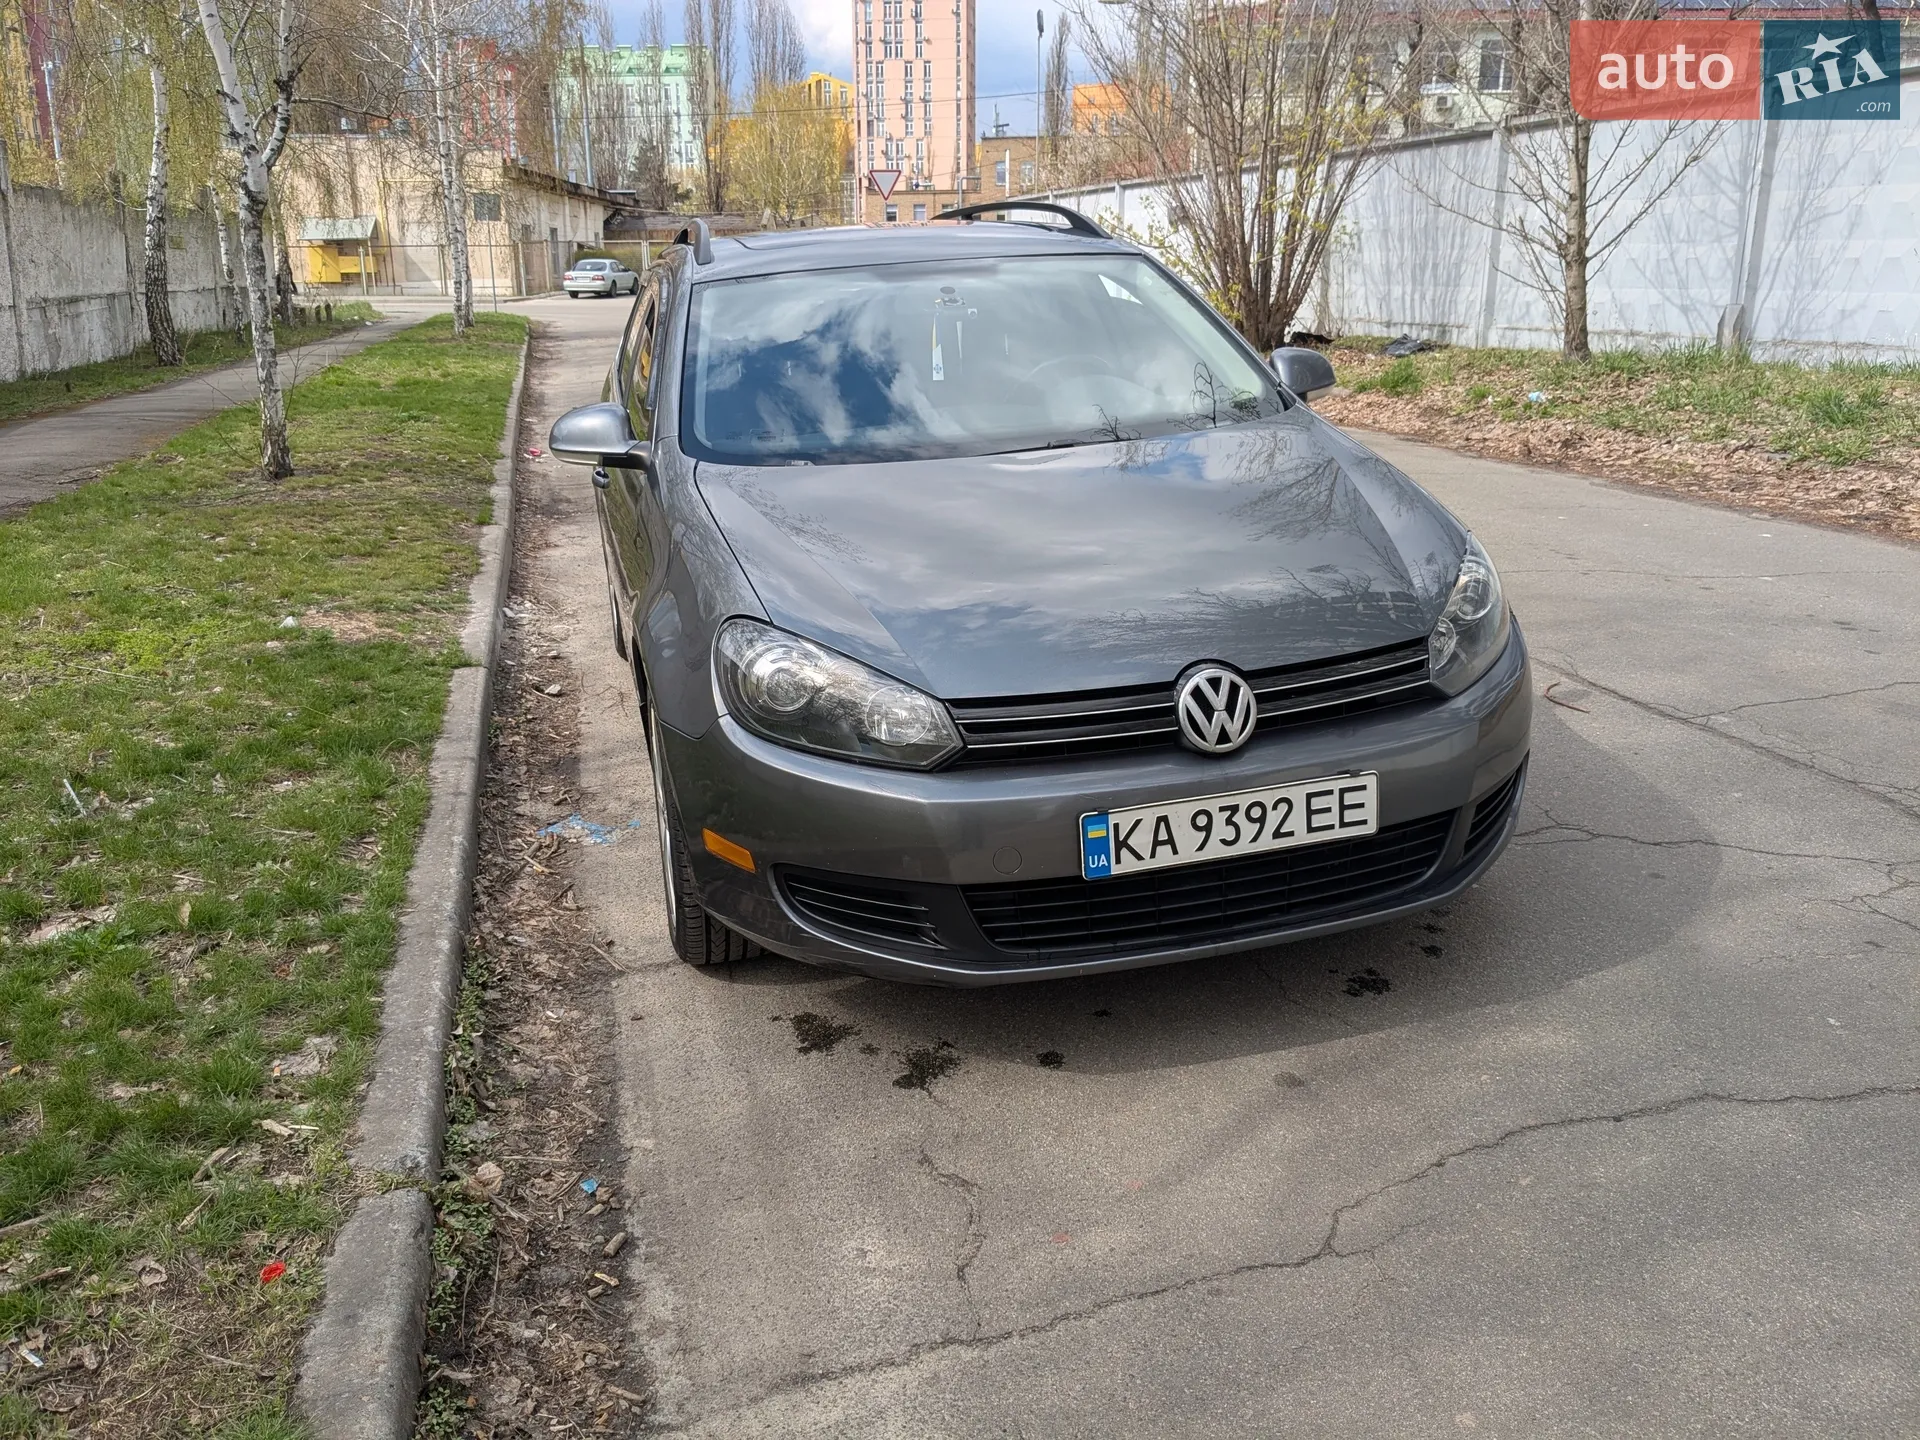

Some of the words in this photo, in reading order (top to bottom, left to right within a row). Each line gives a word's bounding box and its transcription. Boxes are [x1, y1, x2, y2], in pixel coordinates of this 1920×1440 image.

[1112, 814, 1179, 865] KA
[1190, 796, 1295, 852] 9392
[1305, 784, 1368, 834] EE
[1088, 853, 1109, 869] UA
